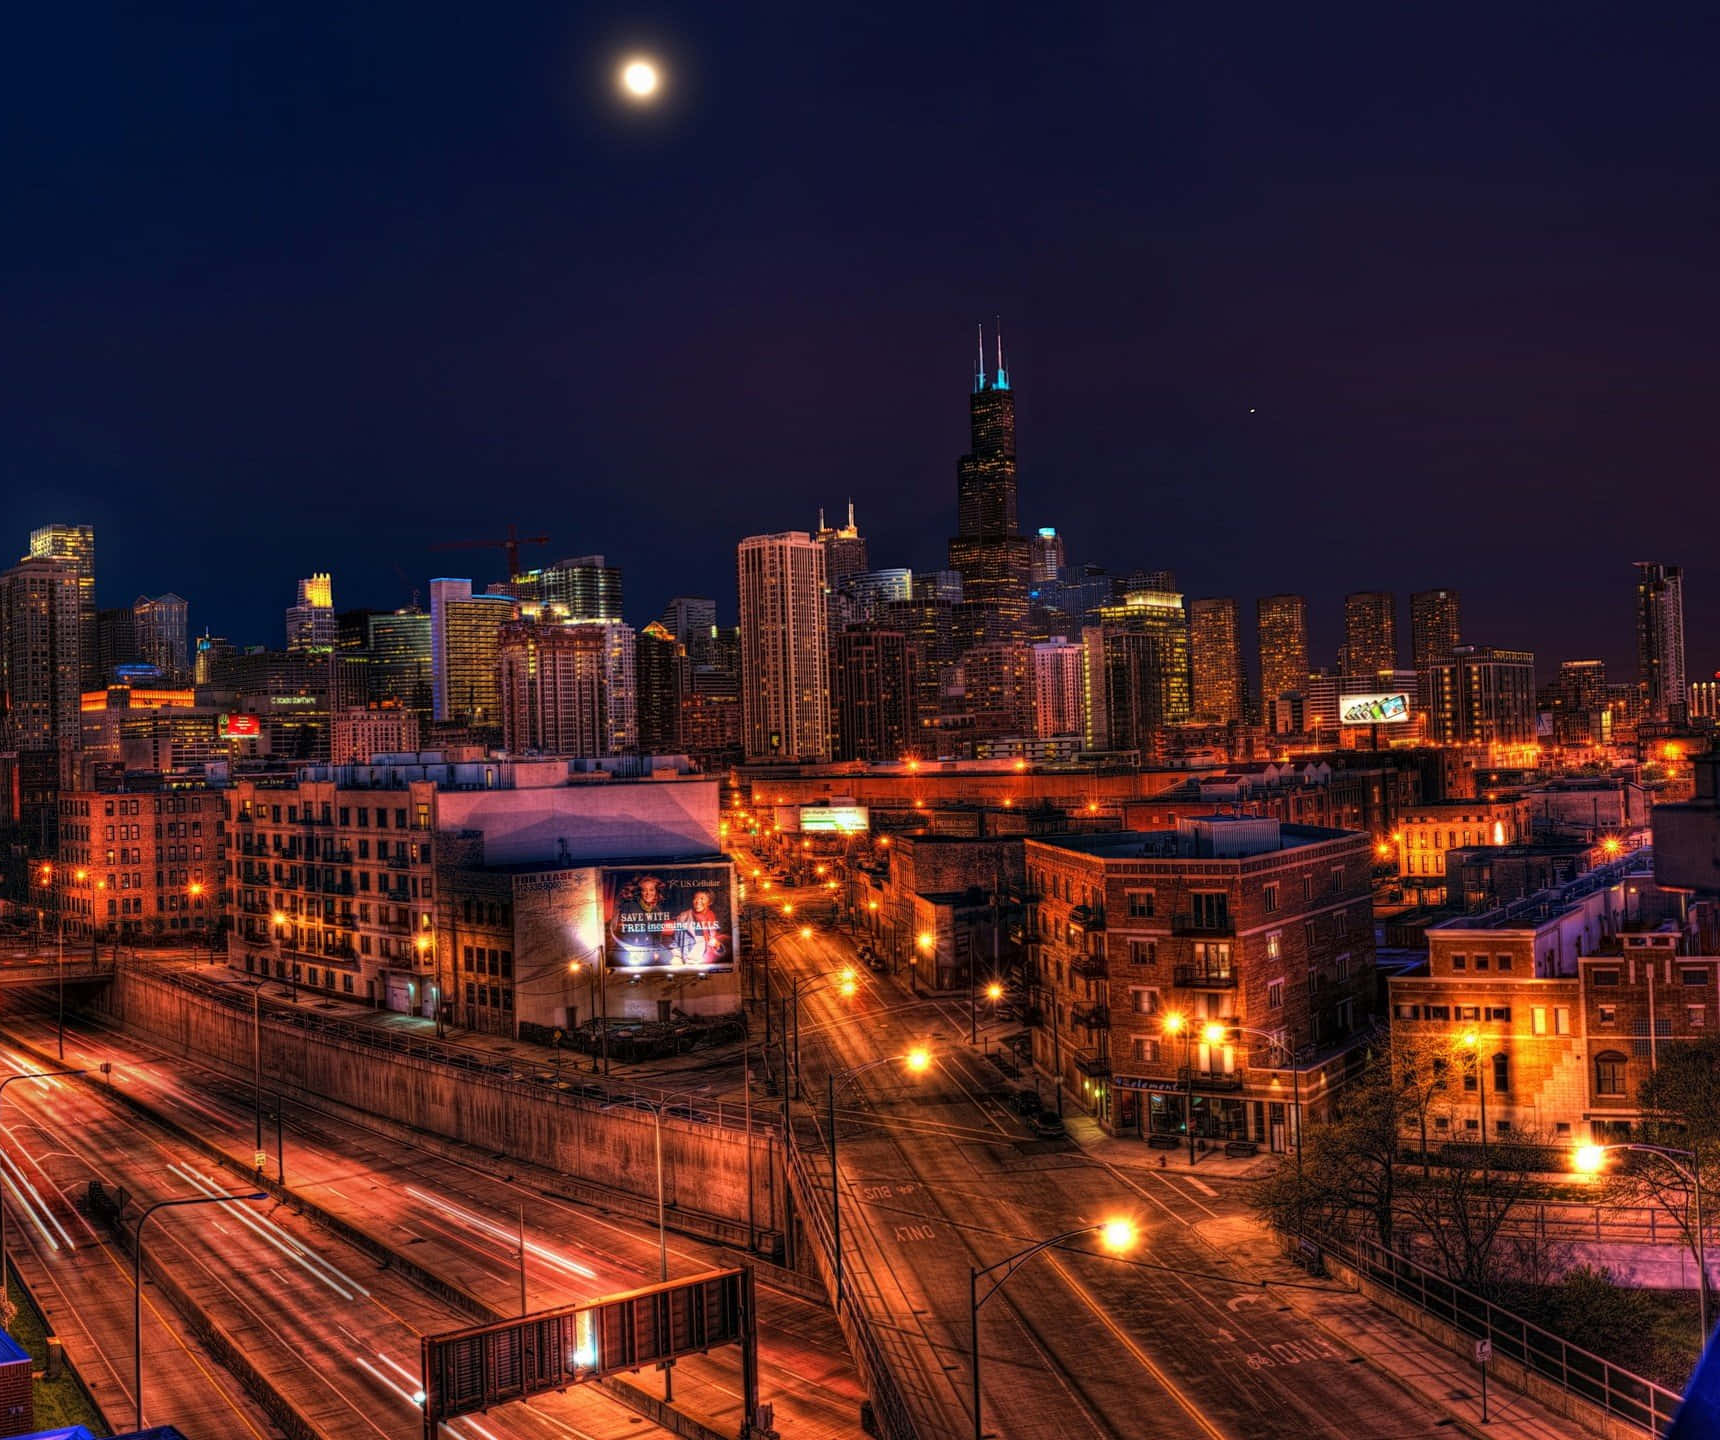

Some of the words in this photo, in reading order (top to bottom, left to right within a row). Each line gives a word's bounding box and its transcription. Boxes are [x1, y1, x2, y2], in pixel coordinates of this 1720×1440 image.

[621, 912, 644, 922] SAVE
[646, 911, 670, 921] WITH
[621, 923, 646, 933] FREE
[647, 922, 690, 932] incoming
[863, 1185, 893, 1200] BUS
[895, 1225, 935, 1241] ONLY
